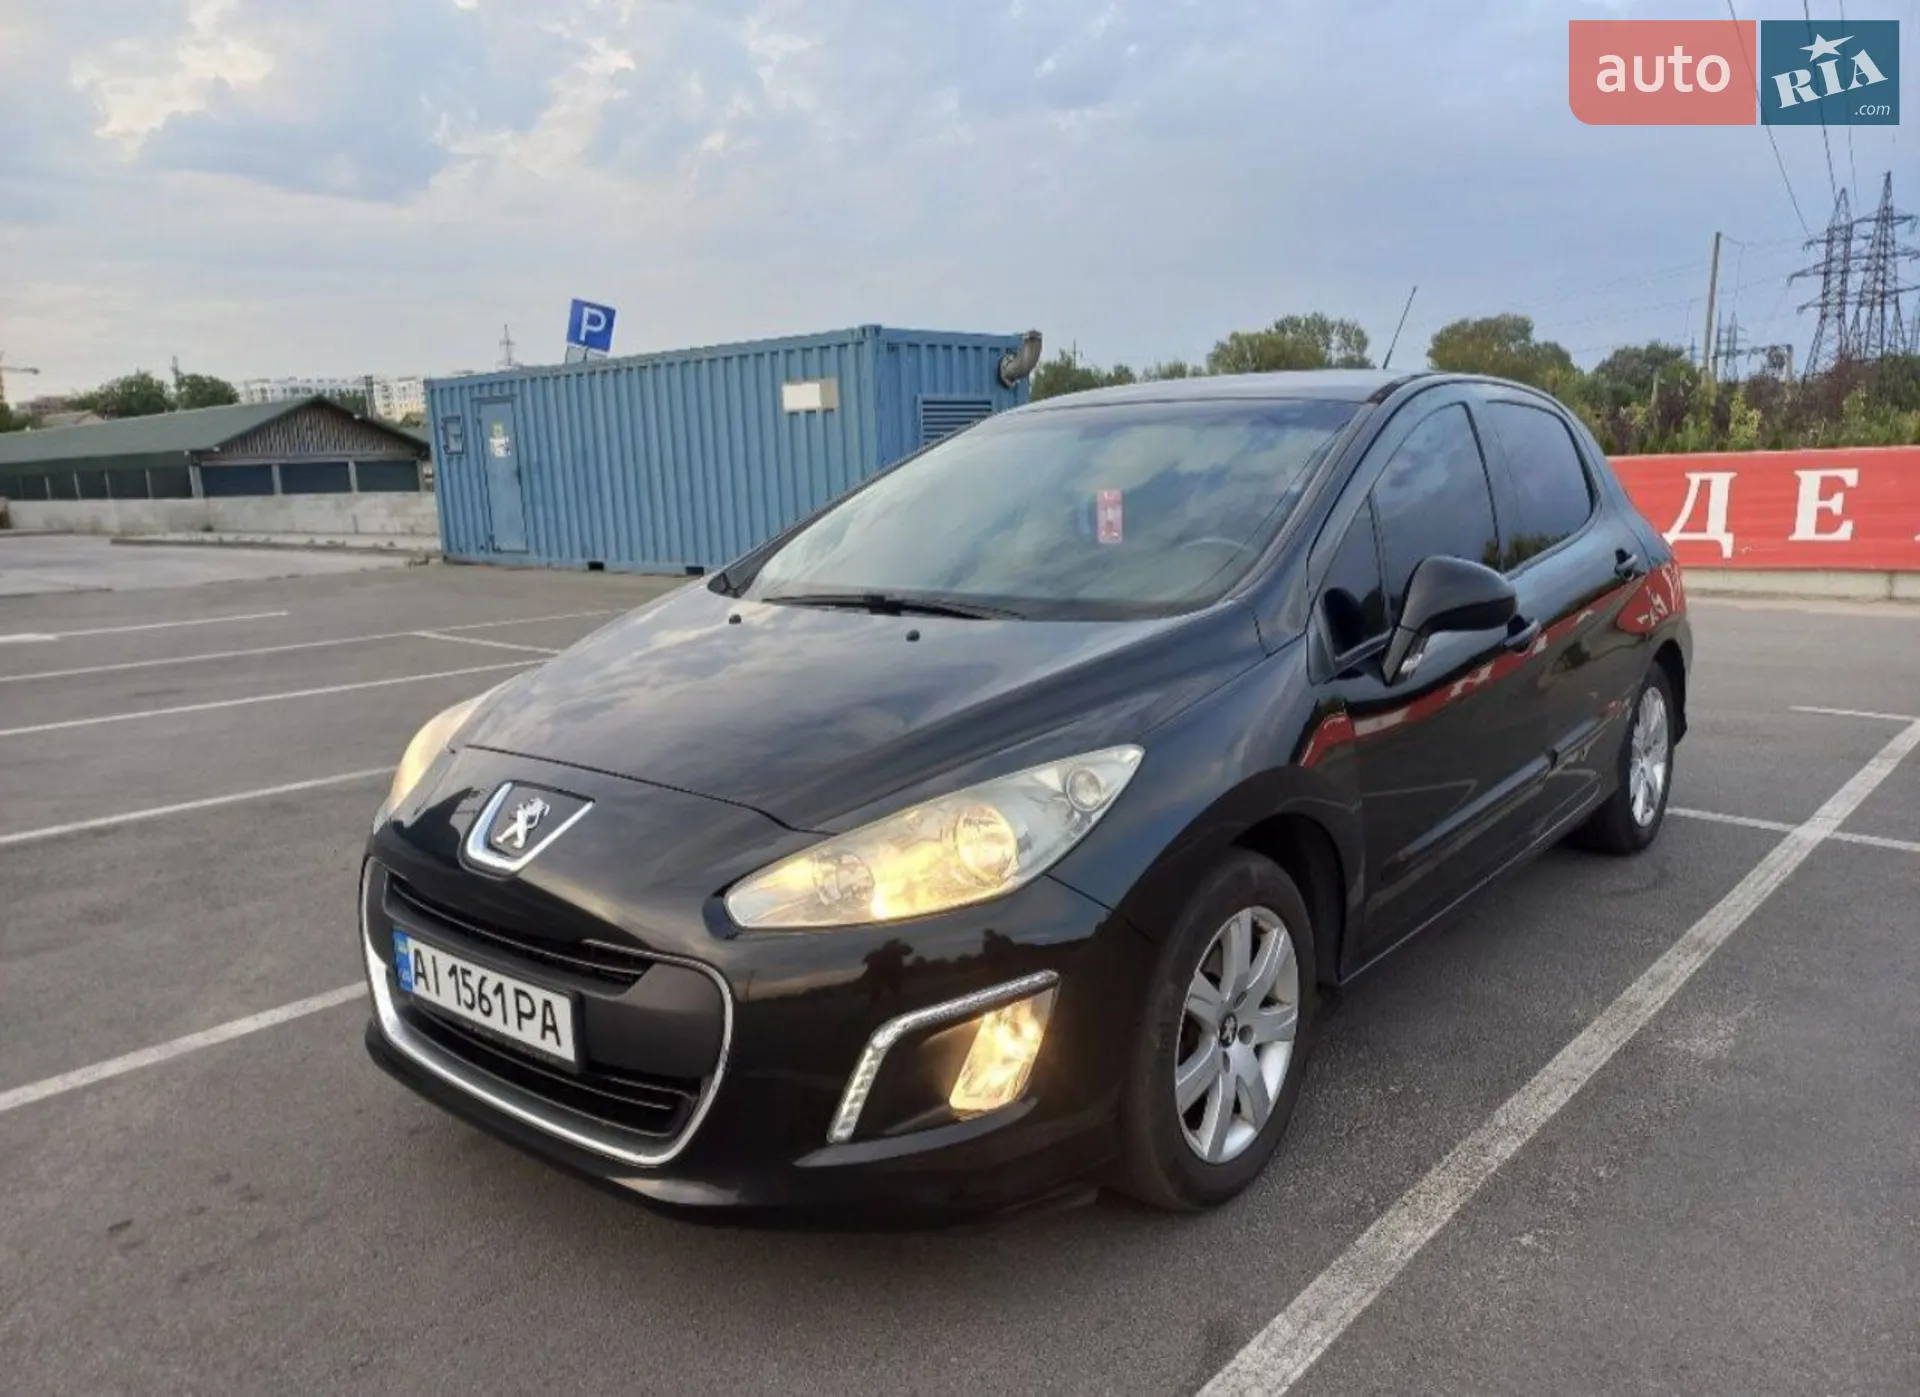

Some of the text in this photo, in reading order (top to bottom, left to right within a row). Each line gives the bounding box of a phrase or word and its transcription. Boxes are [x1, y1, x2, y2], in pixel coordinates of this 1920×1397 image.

[580, 307, 607, 341] P
[1662, 467, 1920, 560] ДЕ
[413, 948, 441, 997] AI
[448, 963, 508, 1026] 1561
[513, 987, 562, 1047] PA
